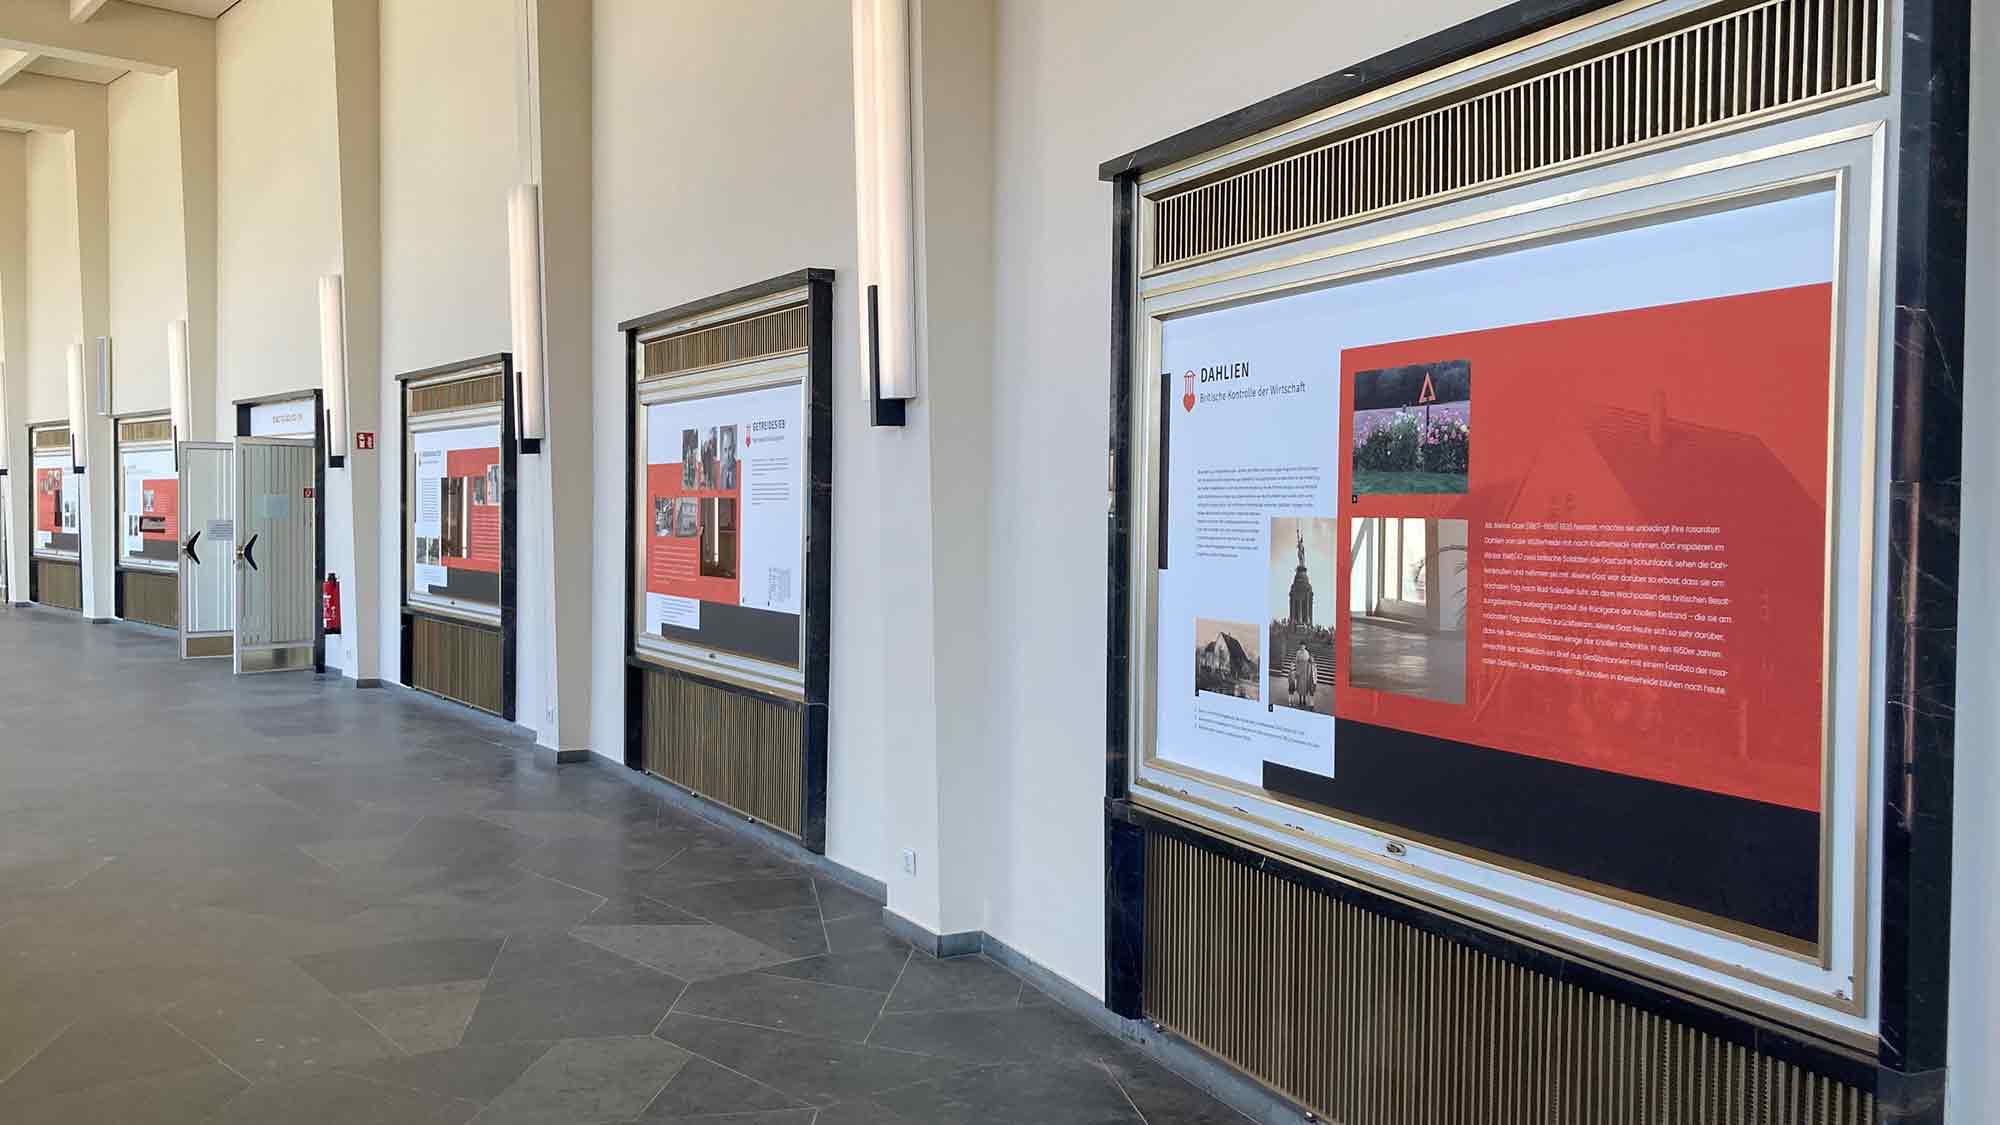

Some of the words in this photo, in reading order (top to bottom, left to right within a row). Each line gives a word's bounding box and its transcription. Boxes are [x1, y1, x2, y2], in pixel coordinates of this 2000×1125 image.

[1200, 361, 1249, 383] DAHLIEN
[1199, 392, 1226, 403] Britische
[1227, 388, 1257, 400] Kontrolle
[1257, 386, 1269, 397] der
[1270, 381, 1306, 395] Wirtschaft
[1636, 525, 1669, 534] unbedingt
[1661, 542, 1676, 550] Dort
[1674, 559, 1696, 568] sehen
[1709, 560, 1728, 569] Dah-
[1681, 577, 1698, 586] dass
[1672, 594, 1707, 604] britischen
[1658, 610, 1687, 620] bestand
[1696, 648, 1721, 658] Jahren
